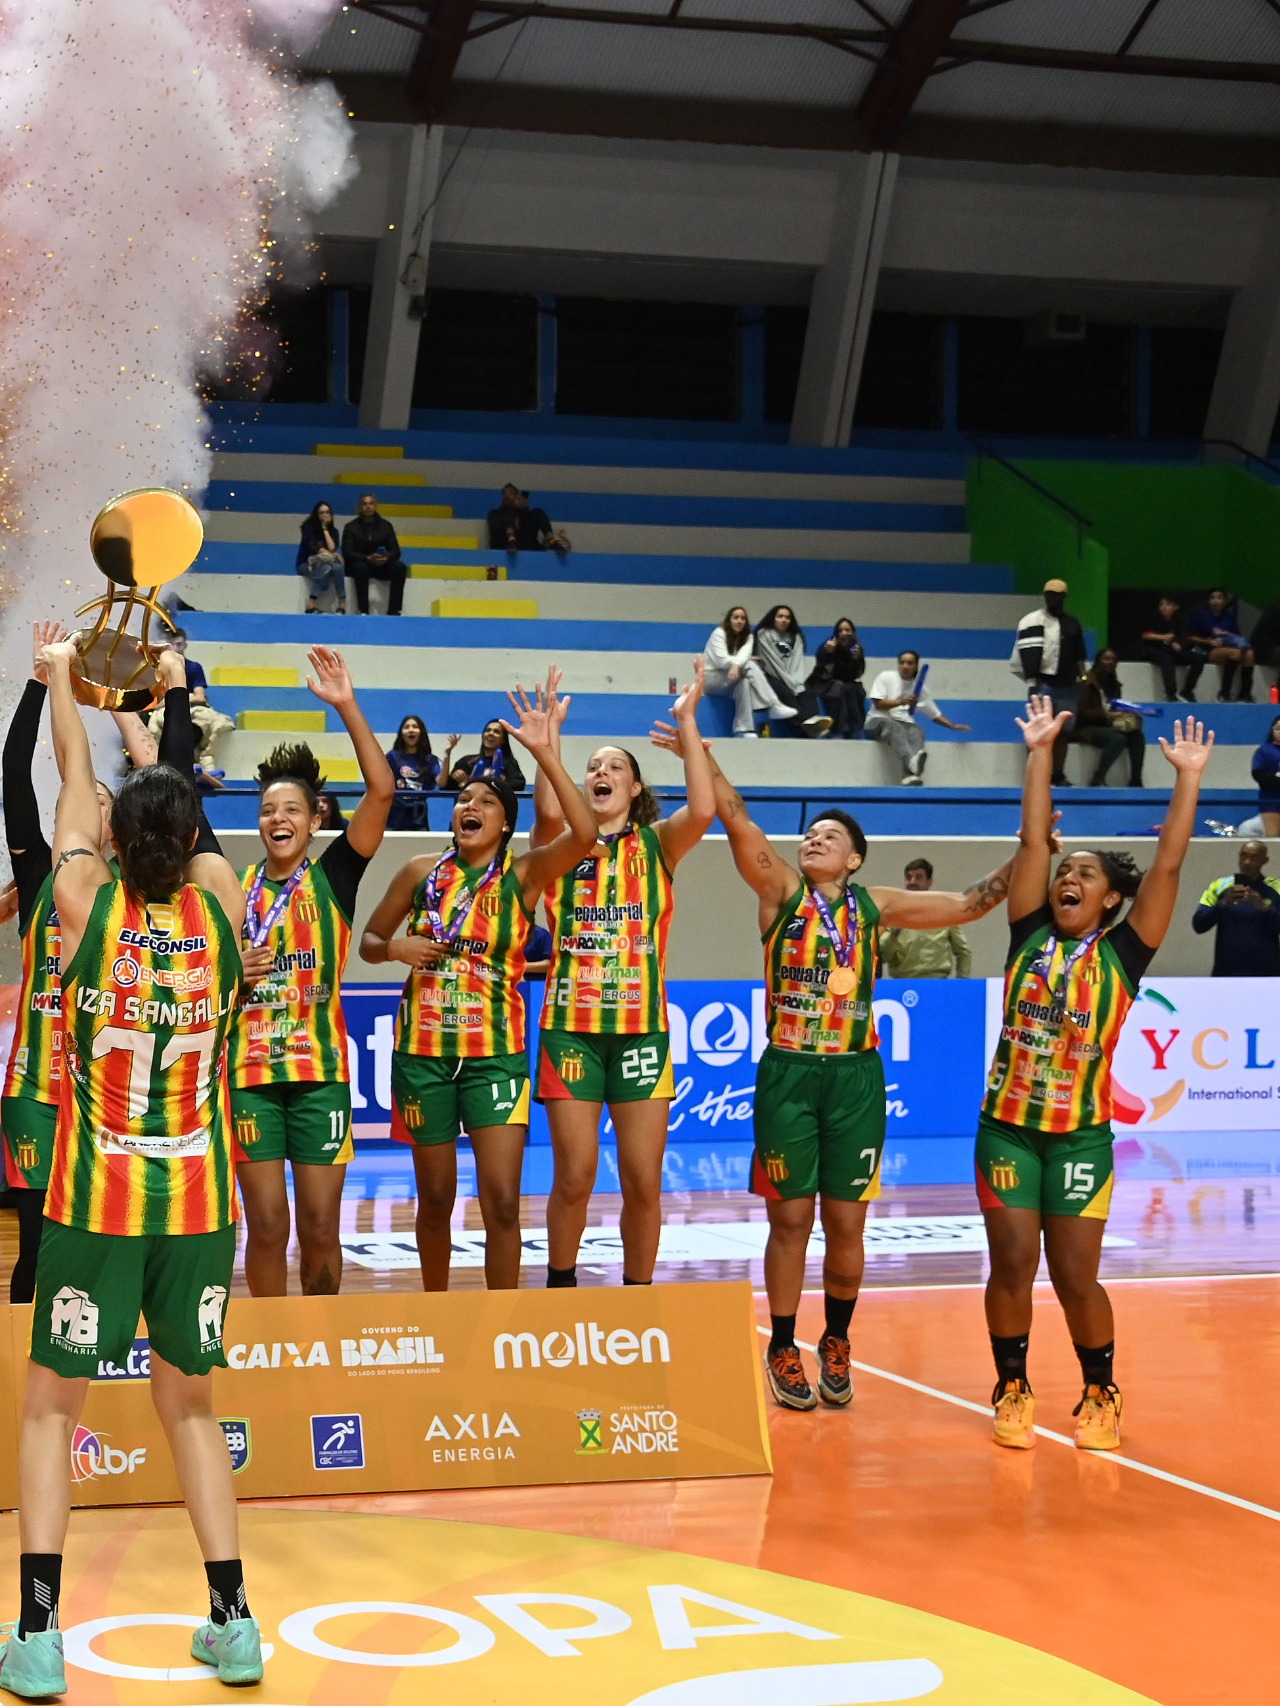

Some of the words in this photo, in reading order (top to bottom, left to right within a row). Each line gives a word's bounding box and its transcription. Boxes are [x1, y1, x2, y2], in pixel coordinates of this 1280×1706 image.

[575, 902, 643, 922] equatorial
[119, 930, 207, 954] ELECONSIL
[140, 966, 213, 986] ENERGIA
[77, 986, 116, 1017] IZA
[604, 989, 640, 1000] ERGUS
[444, 1013, 482, 1025] ERGUS
[92, 1025, 218, 1122] 77
[622, 1046, 659, 1079] 22
[1188, 1086, 1272, 1100] International
[328, 1110, 345, 1140] 11
[860, 1148, 876, 1175] 7
[1063, 1162, 1095, 1191] 15
[51, 1290, 99, 1345] MB
[361, 1326, 404, 1335] GOVERNO
[407, 1325, 420, 1333] DO
[227, 1341, 331, 1370] CAIXA
[340, 1336, 445, 1367] BRASIL
[493, 1322, 671, 1369] molten
[424, 1411, 521, 1442] AXIA
[609, 1410, 677, 1432] SANTO
[432, 1446, 516, 1463] ENERGIA
[611, 1429, 679, 1454] ANDRÉ
[61, 1583, 842, 1680] COPA
